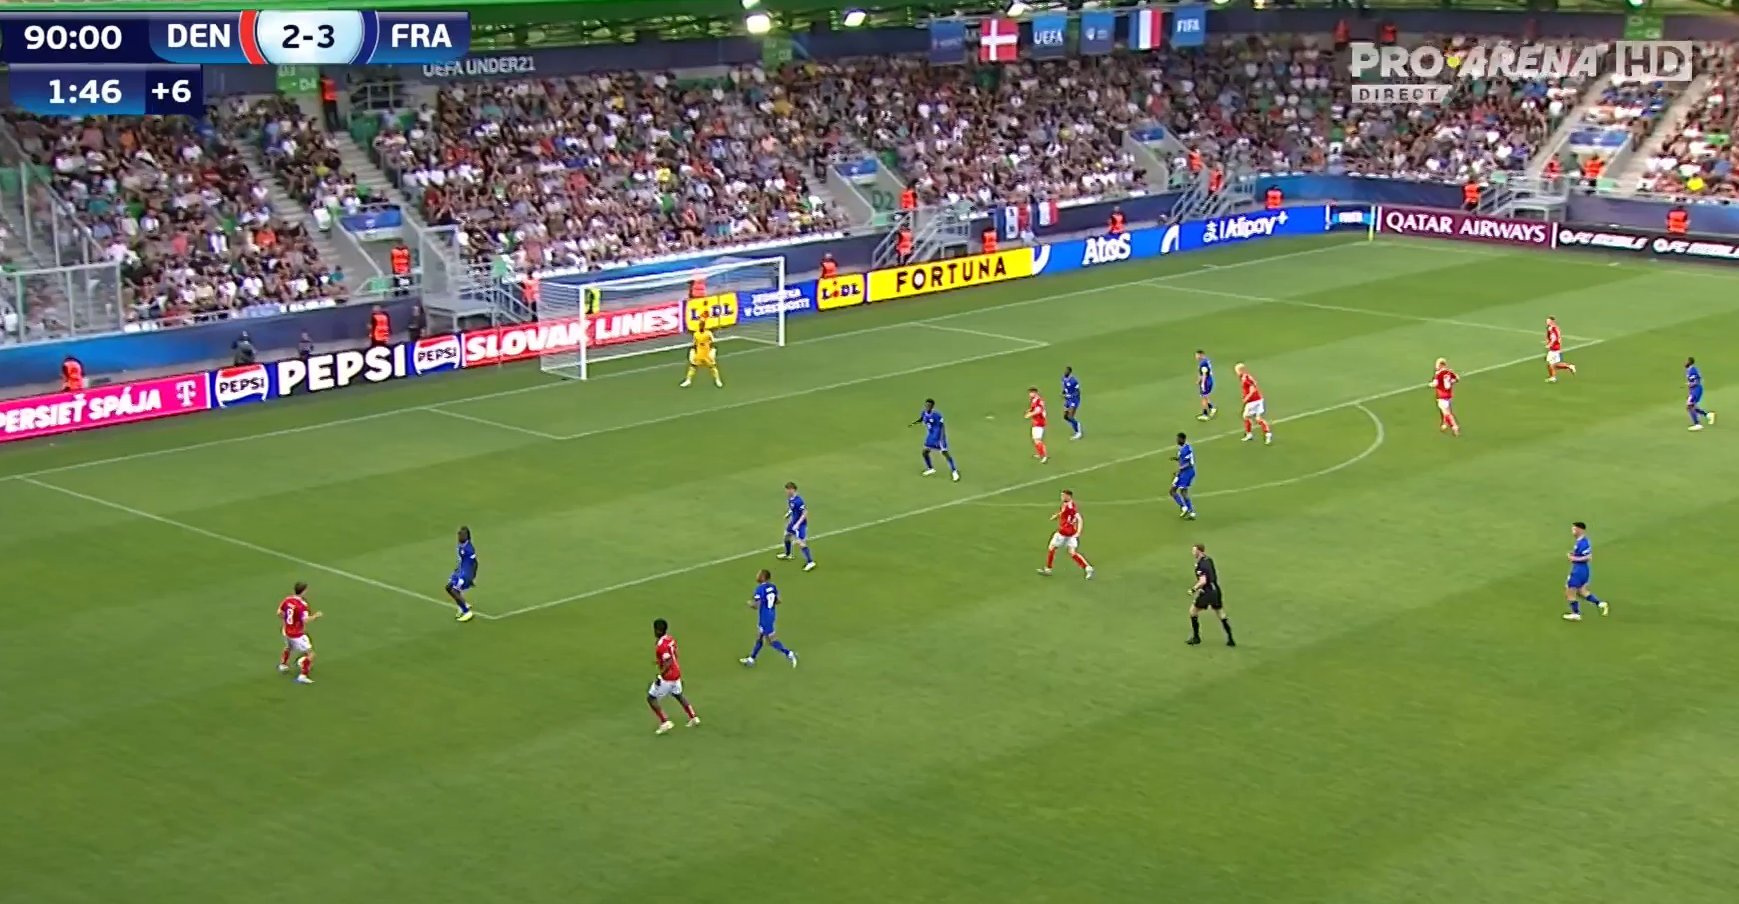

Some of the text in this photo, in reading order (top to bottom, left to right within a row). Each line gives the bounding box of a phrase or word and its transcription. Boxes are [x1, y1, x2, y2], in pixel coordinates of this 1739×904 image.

[1176, 18, 1200, 33] FIFA
[1033, 30, 1063, 45] UEFA
[466, 55, 537, 75] UNDER21
[872, 190, 895, 210] D2
[1386, 211, 1453, 234] QATAR
[1459, 218, 1547, 243] AIRWAYS
[896, 255, 1007, 292] FORTUNA
[466, 305, 679, 361] SLOVAK LINES
[417, 346, 457, 362] PEPSI
[277, 344, 406, 396] PEPSI
[219, 377, 265, 395] PEPSI
[88, 386, 162, 420] SPÁJA
[286, 609, 294, 624] 8
